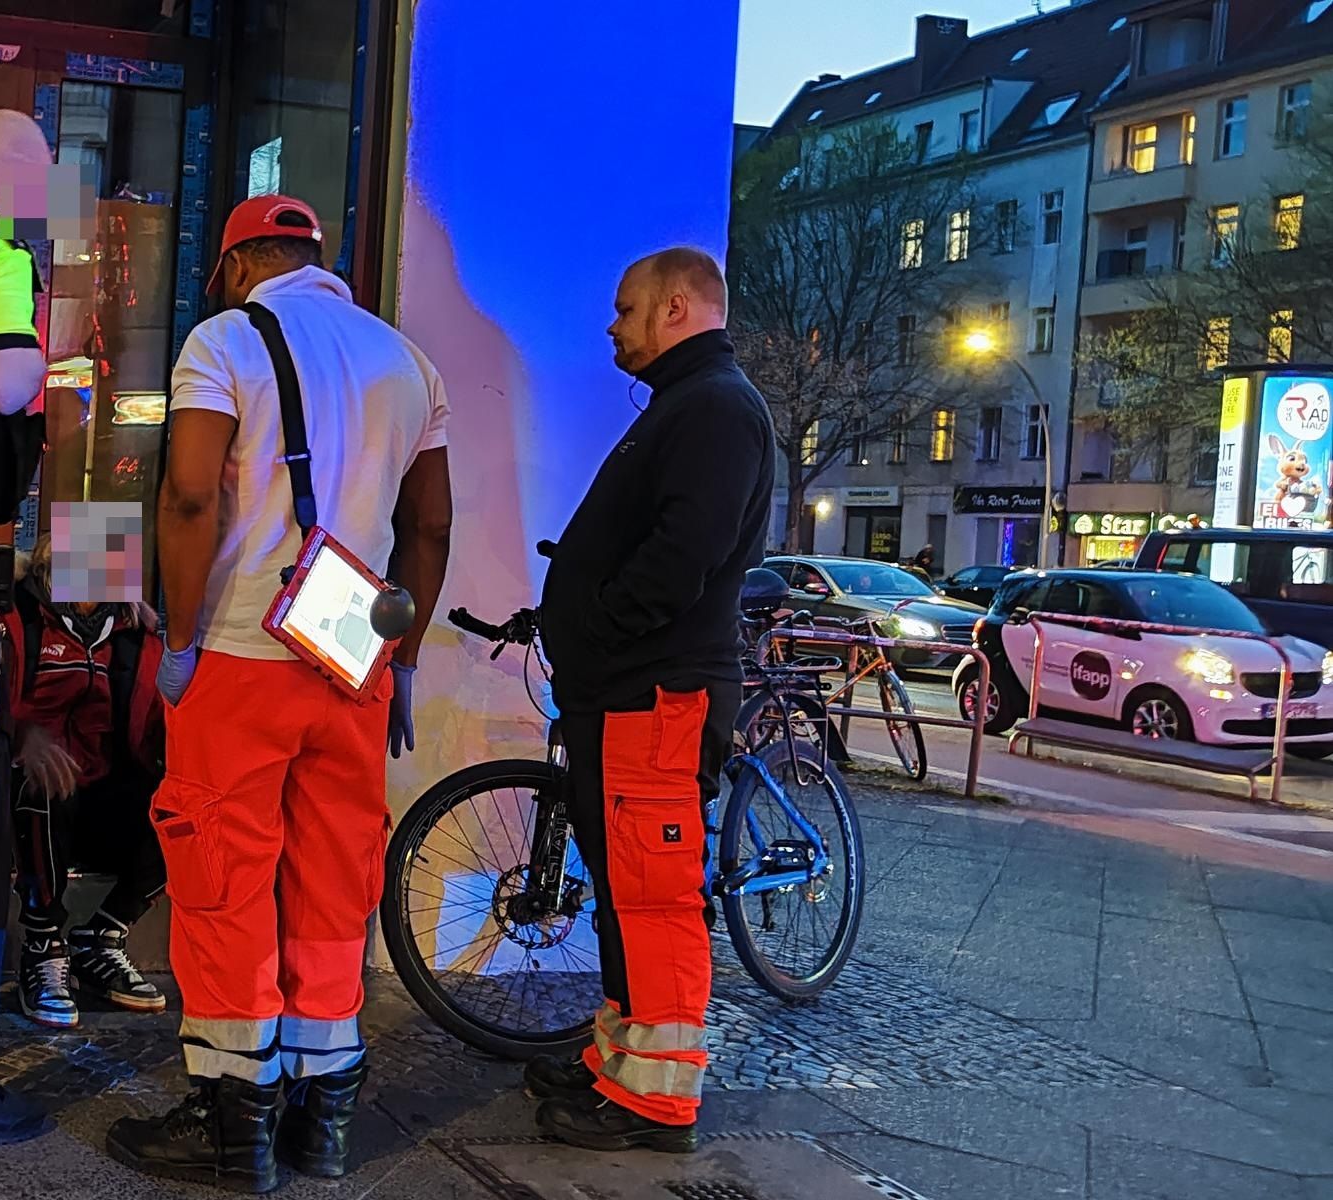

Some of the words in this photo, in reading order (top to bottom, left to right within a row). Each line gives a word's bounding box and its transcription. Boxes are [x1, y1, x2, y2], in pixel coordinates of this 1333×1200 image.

[1301, 422, 1325, 431] HAUS
[1223, 443, 1236, 461] IT
[971, 494, 985, 506] Ihr
[987, 494, 1009, 506] Retro
[1011, 494, 1041, 508] Friseur
[1100, 513, 1147, 535] Star
[1072, 662, 1110, 689] ifapp
